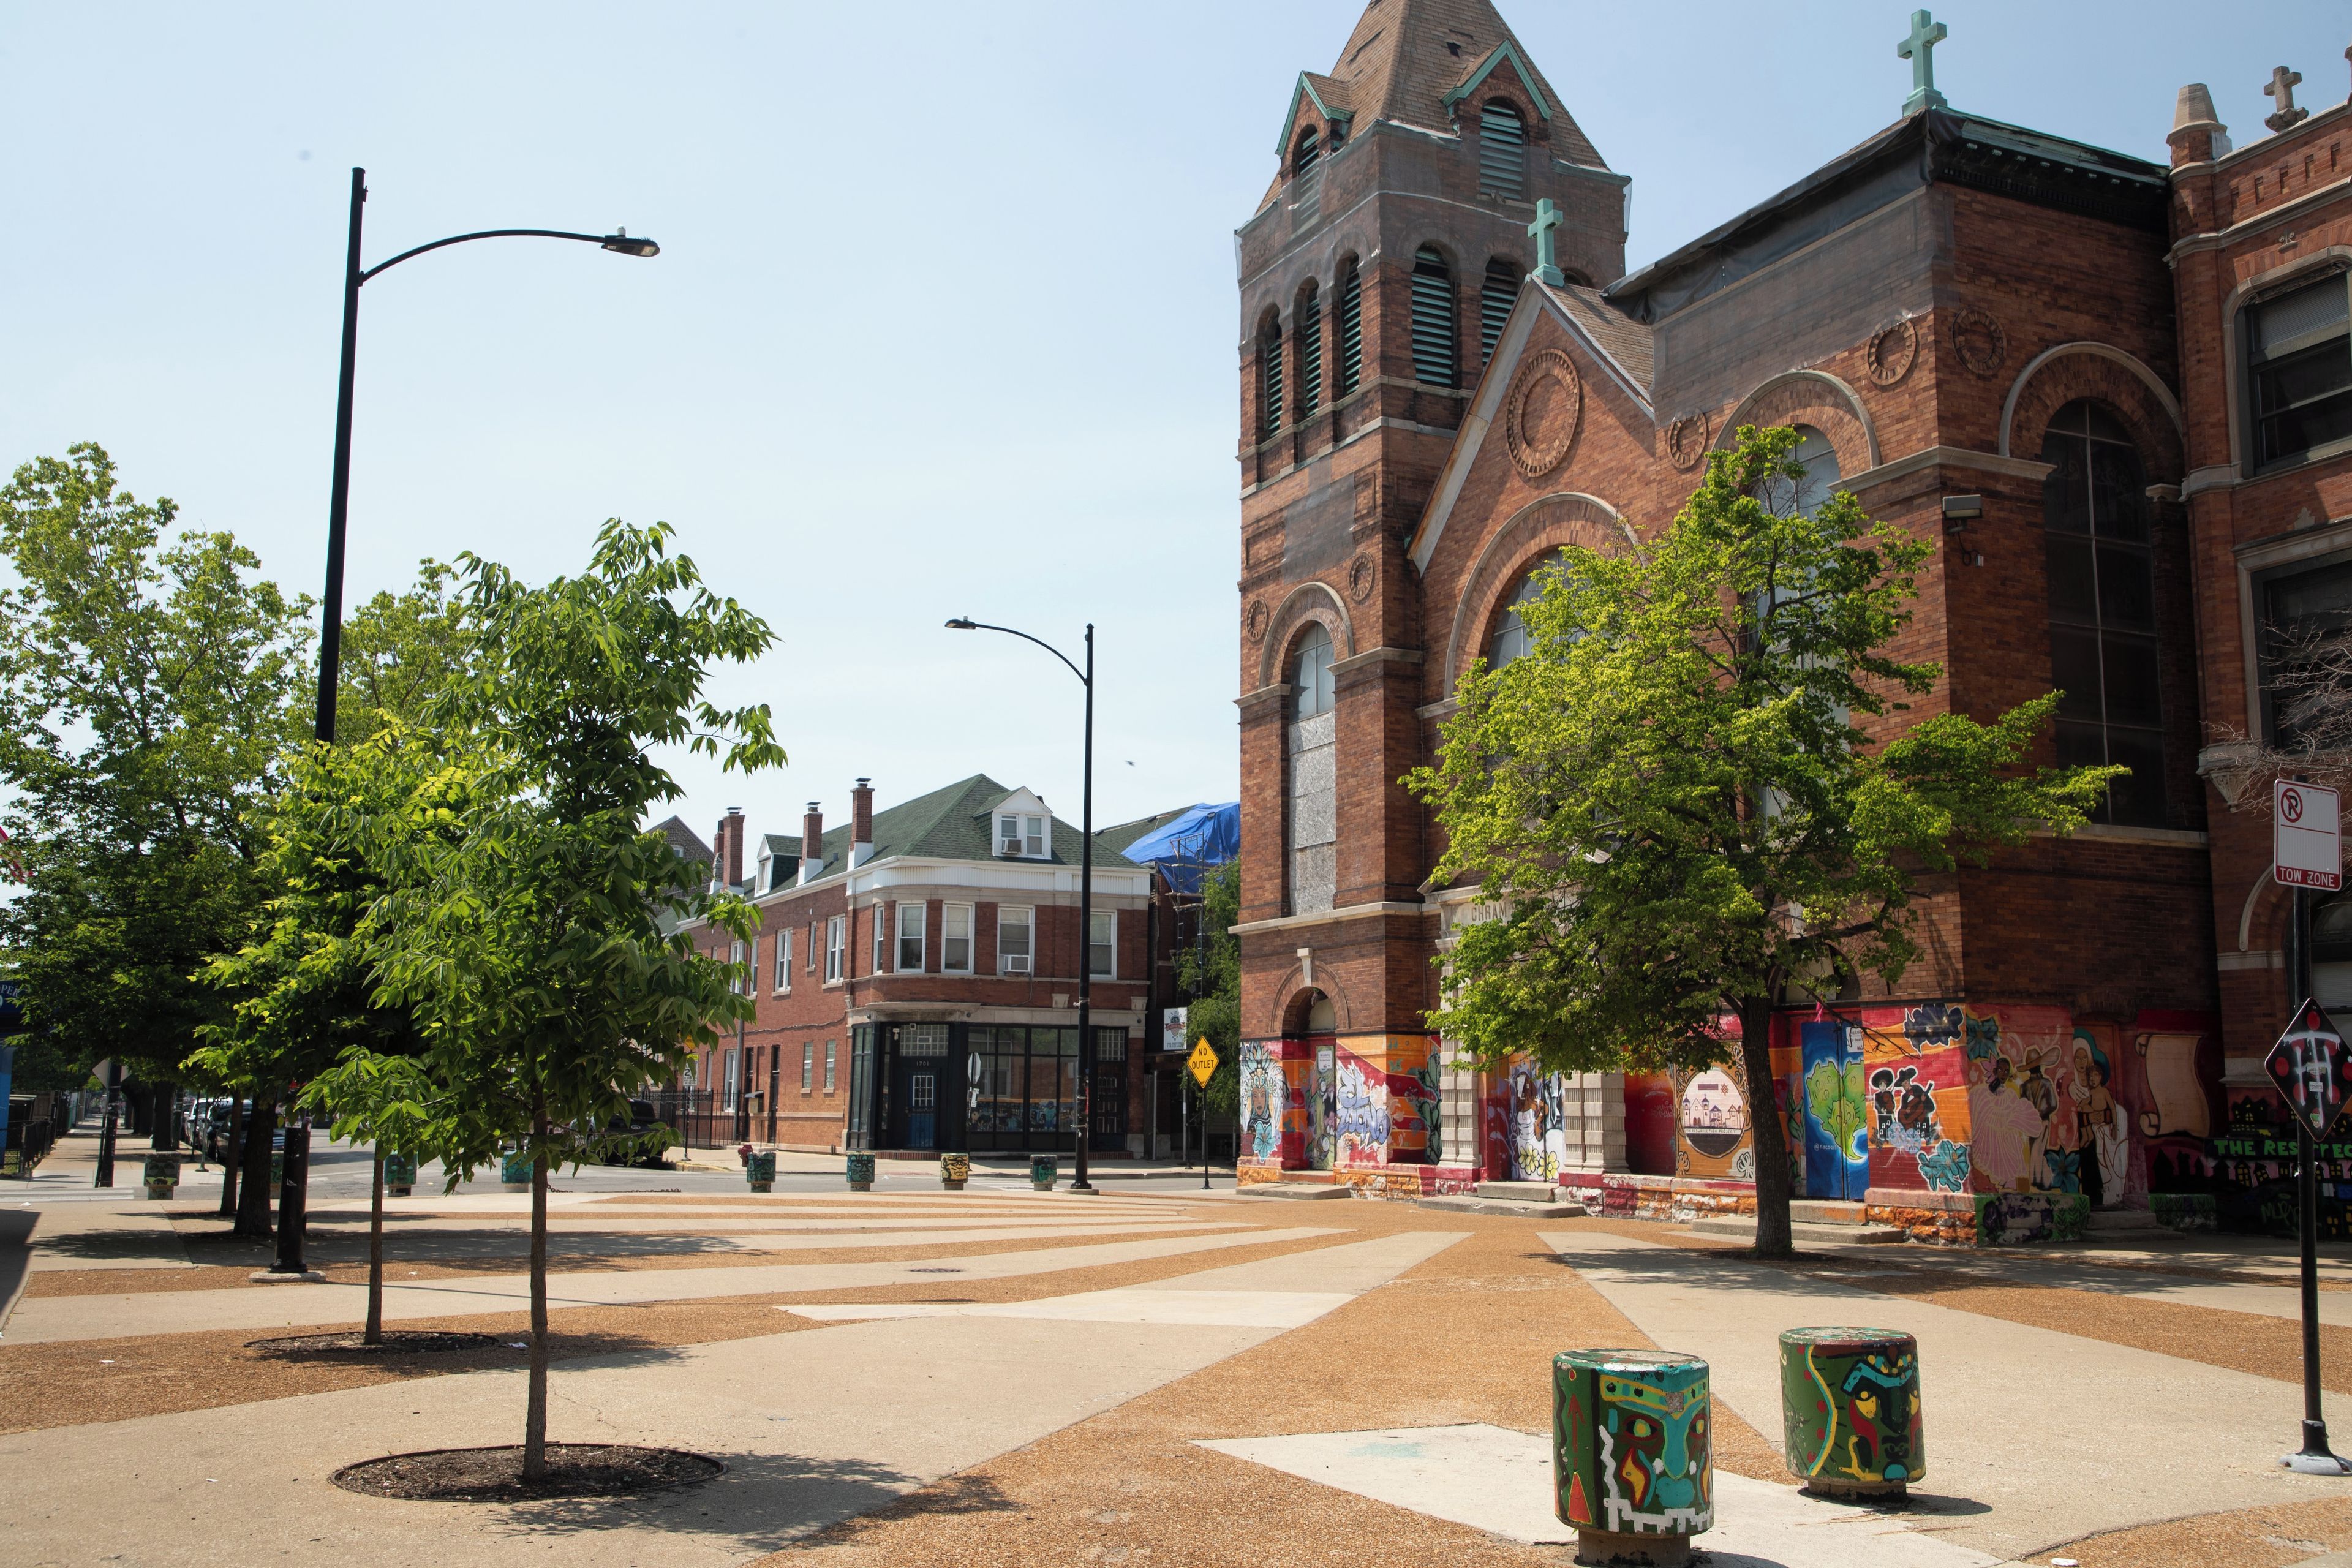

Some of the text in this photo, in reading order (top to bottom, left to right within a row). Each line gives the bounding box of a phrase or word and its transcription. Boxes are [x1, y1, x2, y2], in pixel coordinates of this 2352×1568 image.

[2280, 867, 2335, 887] TOW ZONE
[1471, 902, 1507, 921] CHRAM
[1199, 1047, 1207, 1056] NO
[1192, 1060, 1214, 1069] OUTLET
[2214, 1139, 2256, 1156] THE
